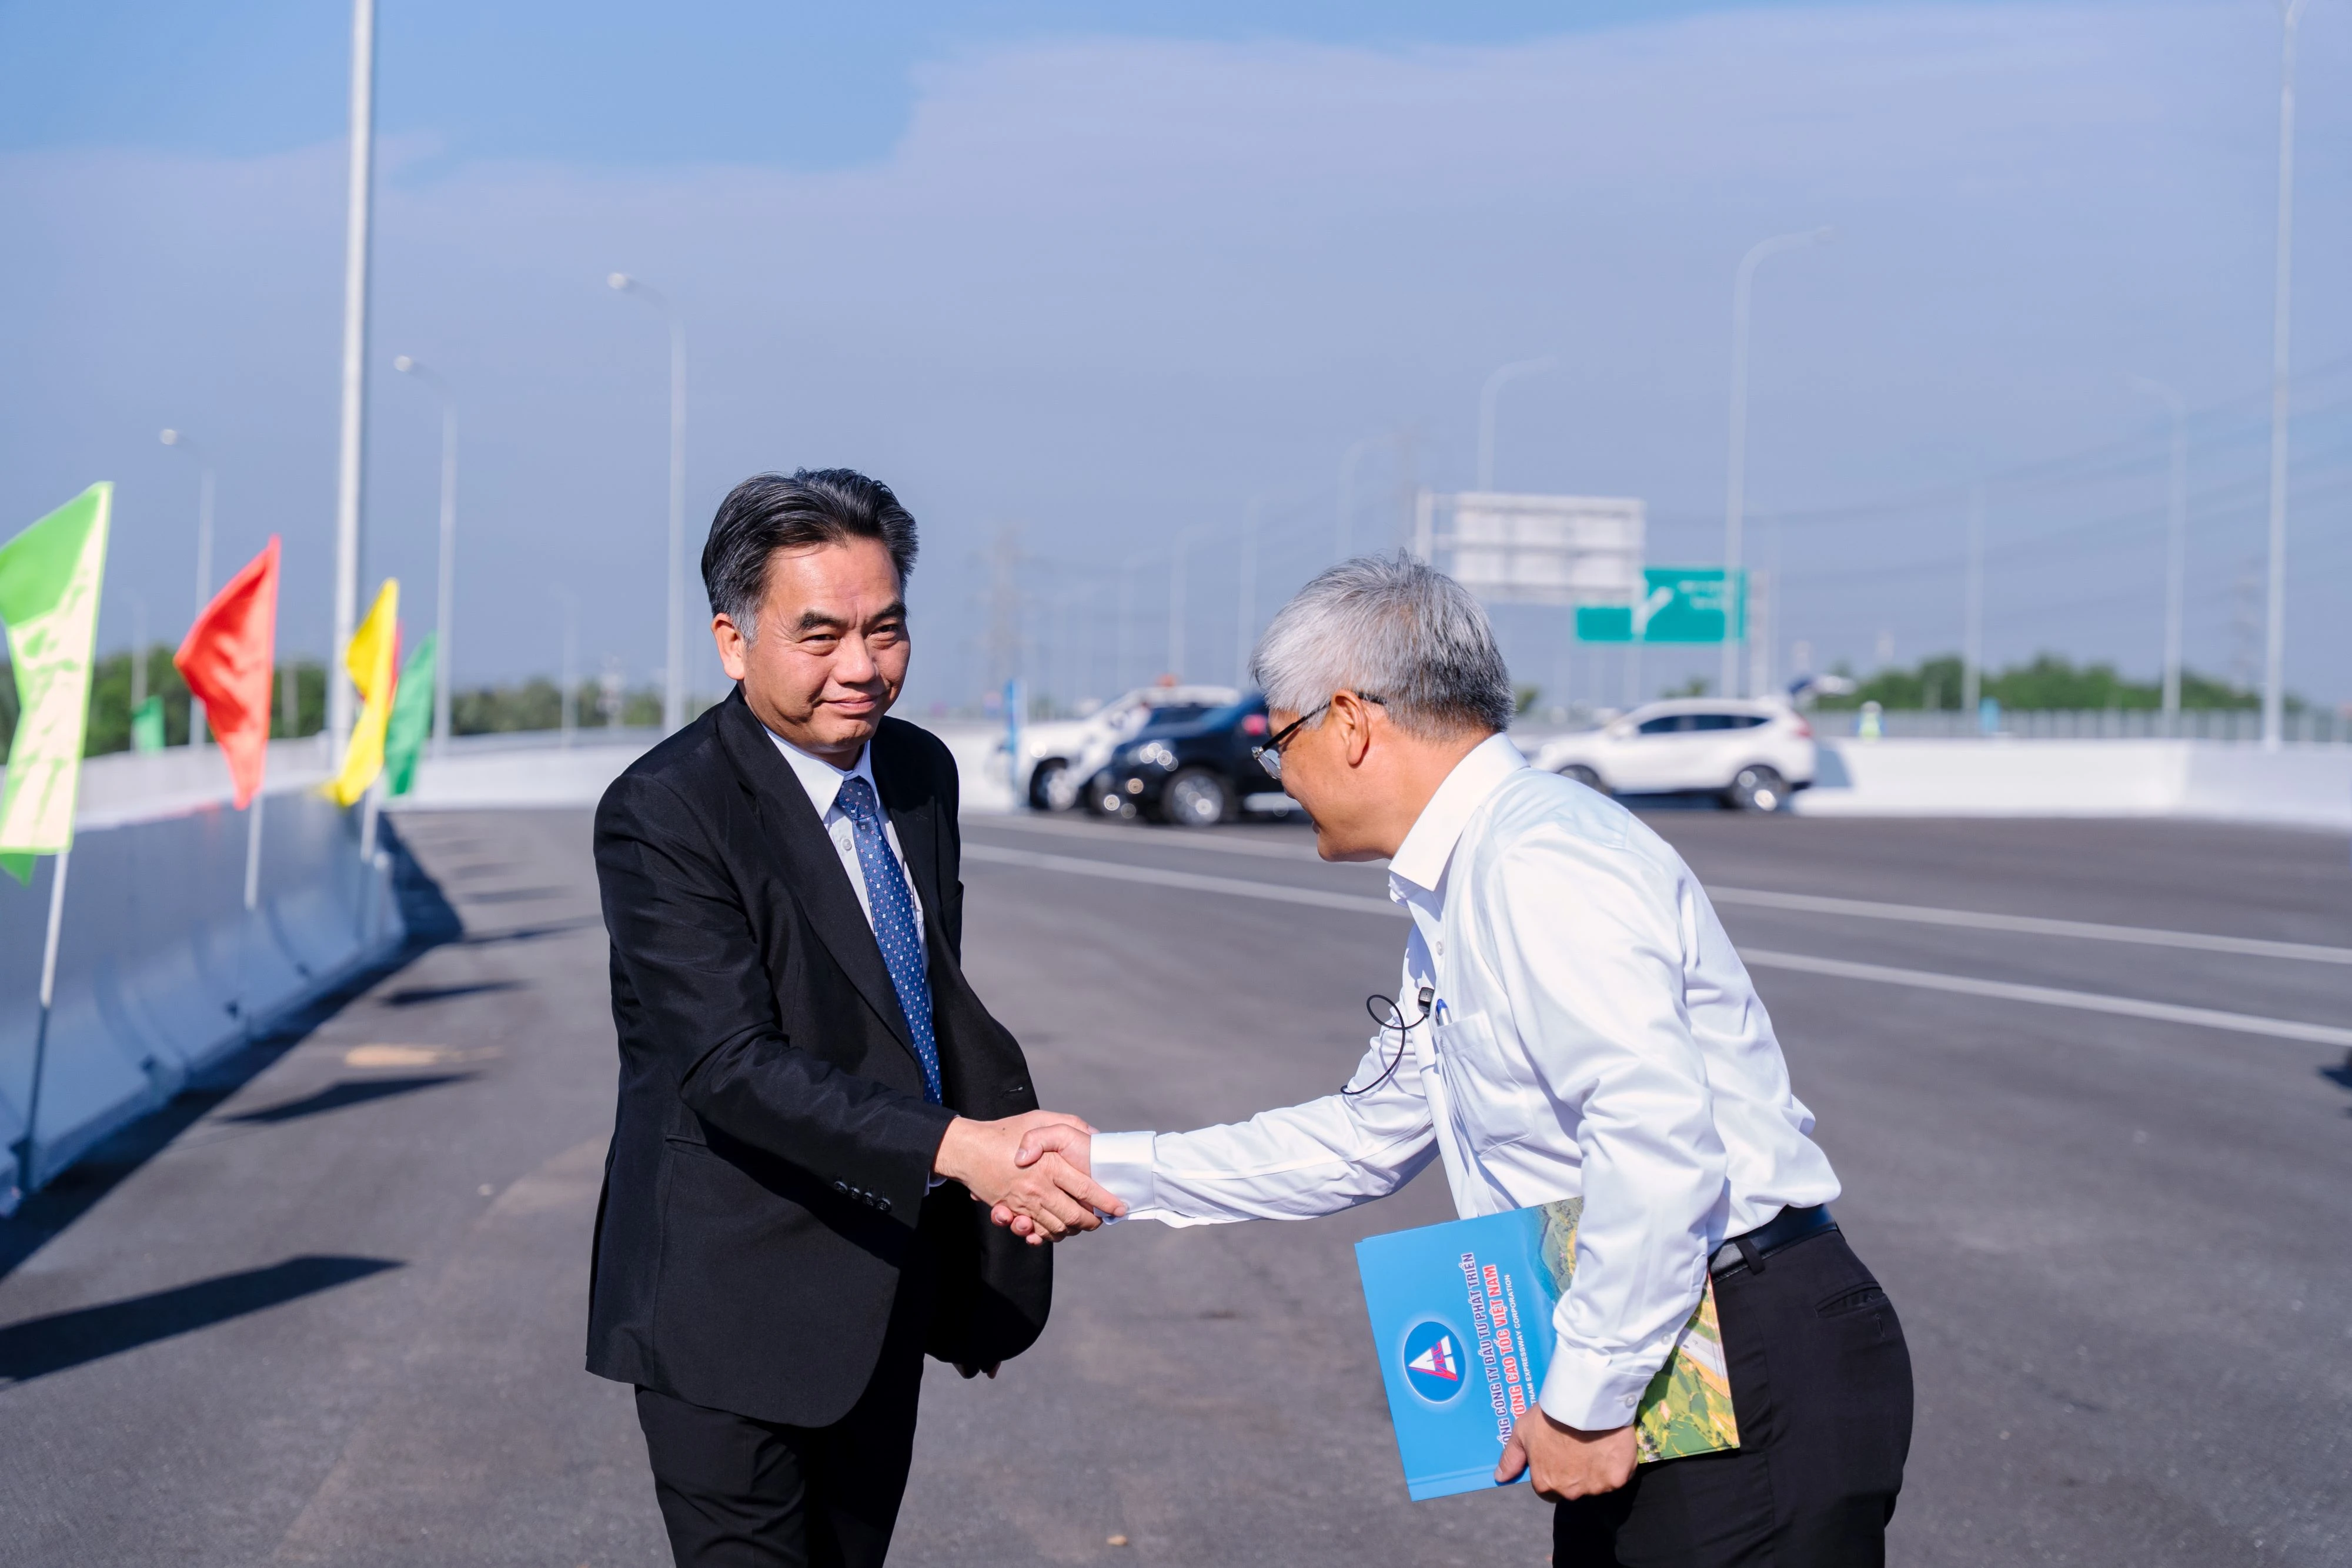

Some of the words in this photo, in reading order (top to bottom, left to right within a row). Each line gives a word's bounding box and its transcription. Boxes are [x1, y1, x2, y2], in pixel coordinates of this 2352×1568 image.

[1459, 1253, 1479, 1289] TRIỂN
[1484, 1265, 1501, 1297] NAM
[1469, 1290, 1485, 1321] PHÁT
[1489, 1299, 1507, 1328] VIỆT
[1505, 1275, 1520, 1328] CORPORATION
[1476, 1322, 1489, 1339] TƯ
[1494, 1329, 1513, 1355] TỐC
[1409, 1341, 1458, 1381] VEC
[1479, 1340, 1495, 1365] ĐẦU
[1516, 1330, 1531, 1381] EXPRESSWAY
[1487, 1366, 1499, 1382] TY
[1503, 1357, 1519, 1383] CAO
[1491, 1384, 1506, 1416] CÔNG
